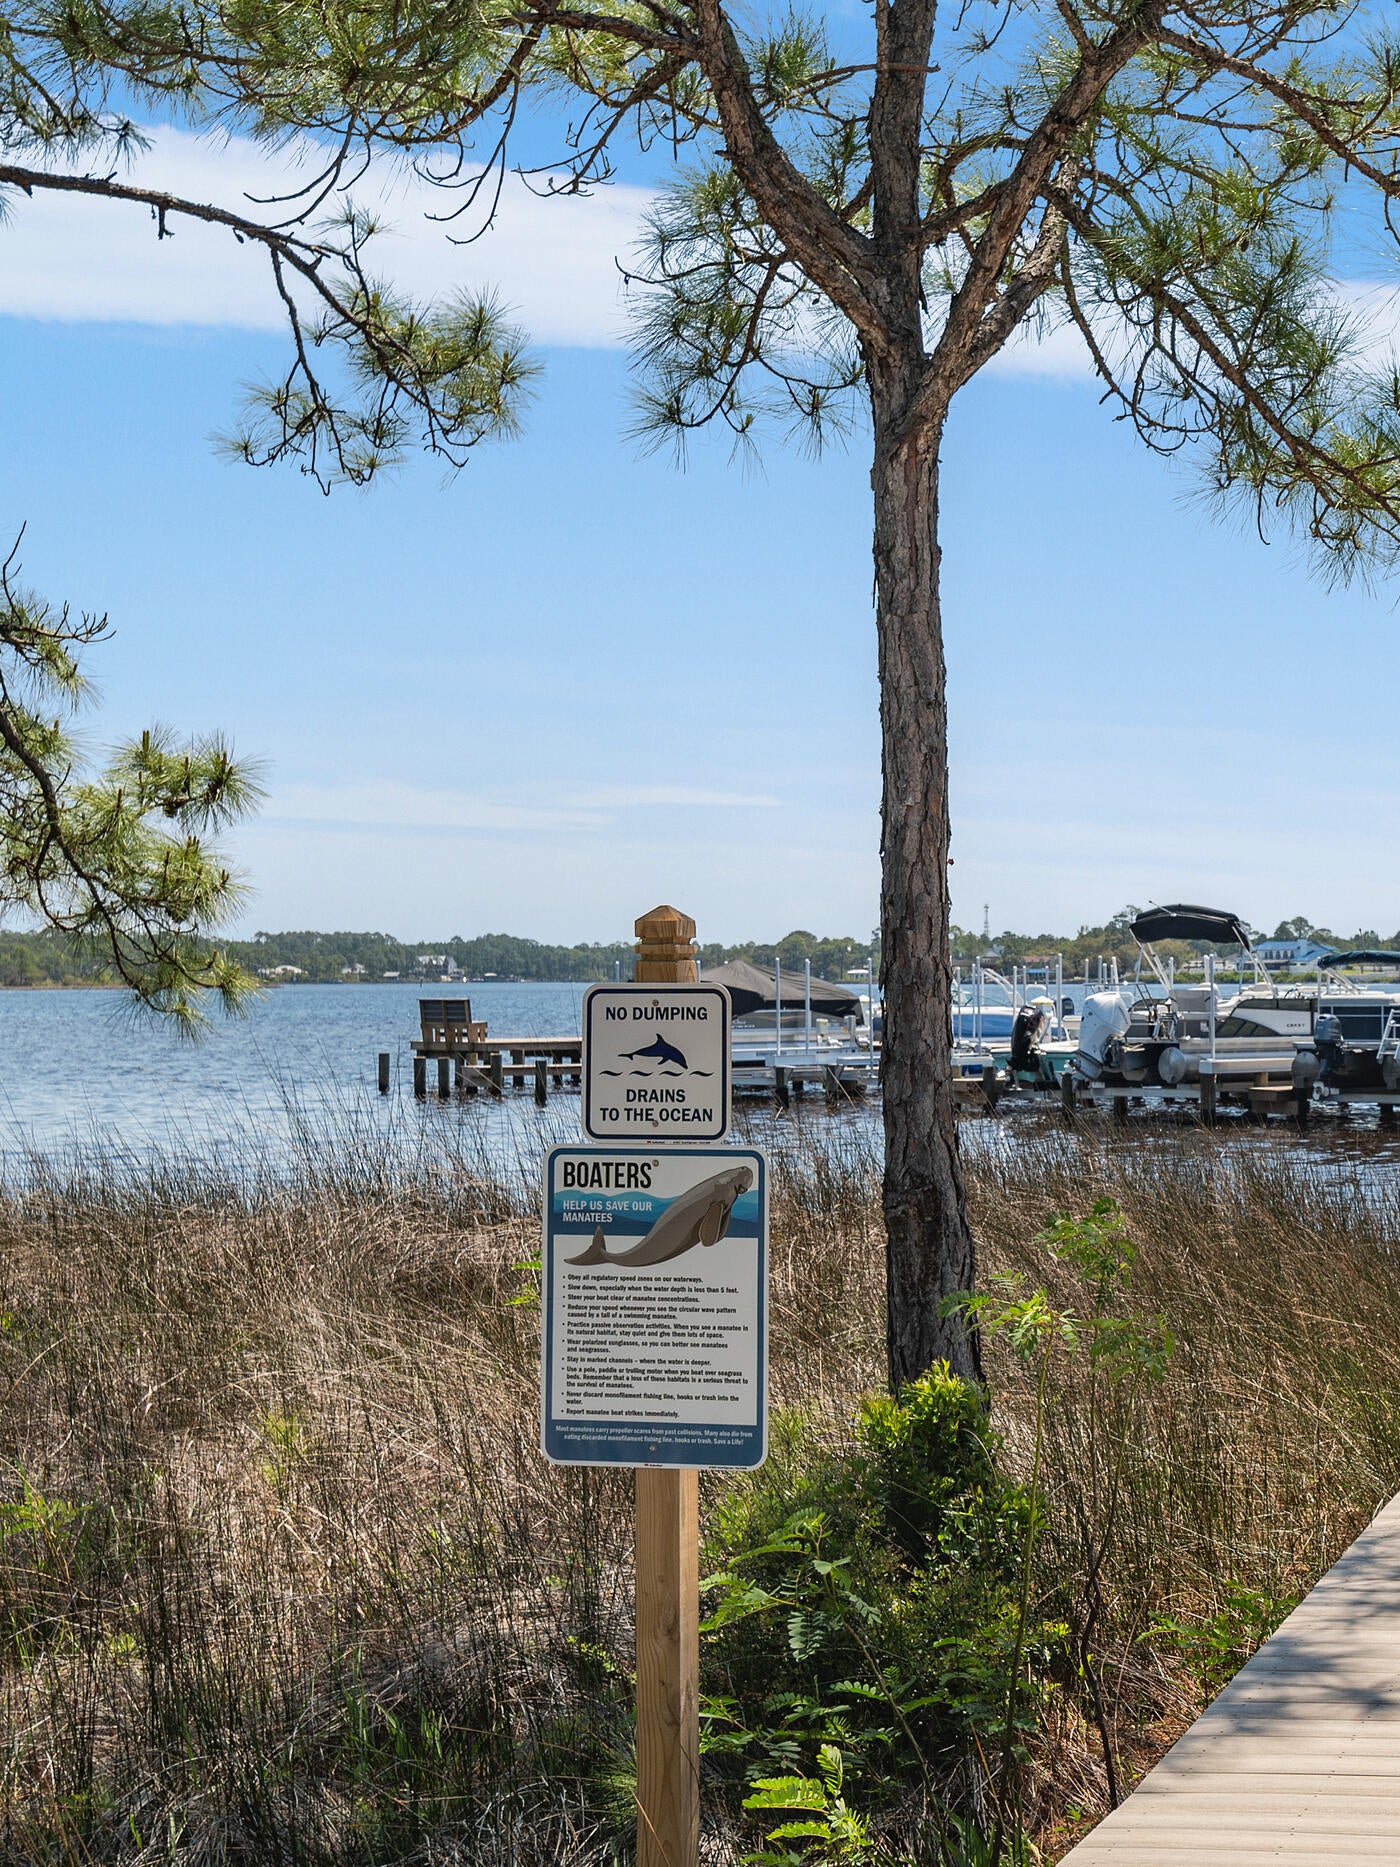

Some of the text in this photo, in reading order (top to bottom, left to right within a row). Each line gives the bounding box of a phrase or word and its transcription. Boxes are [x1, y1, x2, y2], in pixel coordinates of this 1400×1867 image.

[606, 1007, 707, 1020] NO DUMPING
[626, 1089, 685, 1102] DRAINS
[600, 1108, 712, 1122] TO THE OCEAN
[564, 1161, 652, 1189] BOATERS
[563, 1200, 652, 1211] HELP US SAVE OUR
[563, 1213, 613, 1223] MANATEES
[568, 1274, 581, 1282] Obey
[620, 1275, 636, 1283] speed
[673, 1276, 704, 1284] waterways.
[591, 1322, 611, 1330] passive
[632, 1330, 647, 1338] quiet
[567, 1356, 579, 1364] Stay
[691, 1359, 712, 1367] deeper.
[643, 1393, 662, 1401] fishing
[566, 1408, 585, 1416] Report
